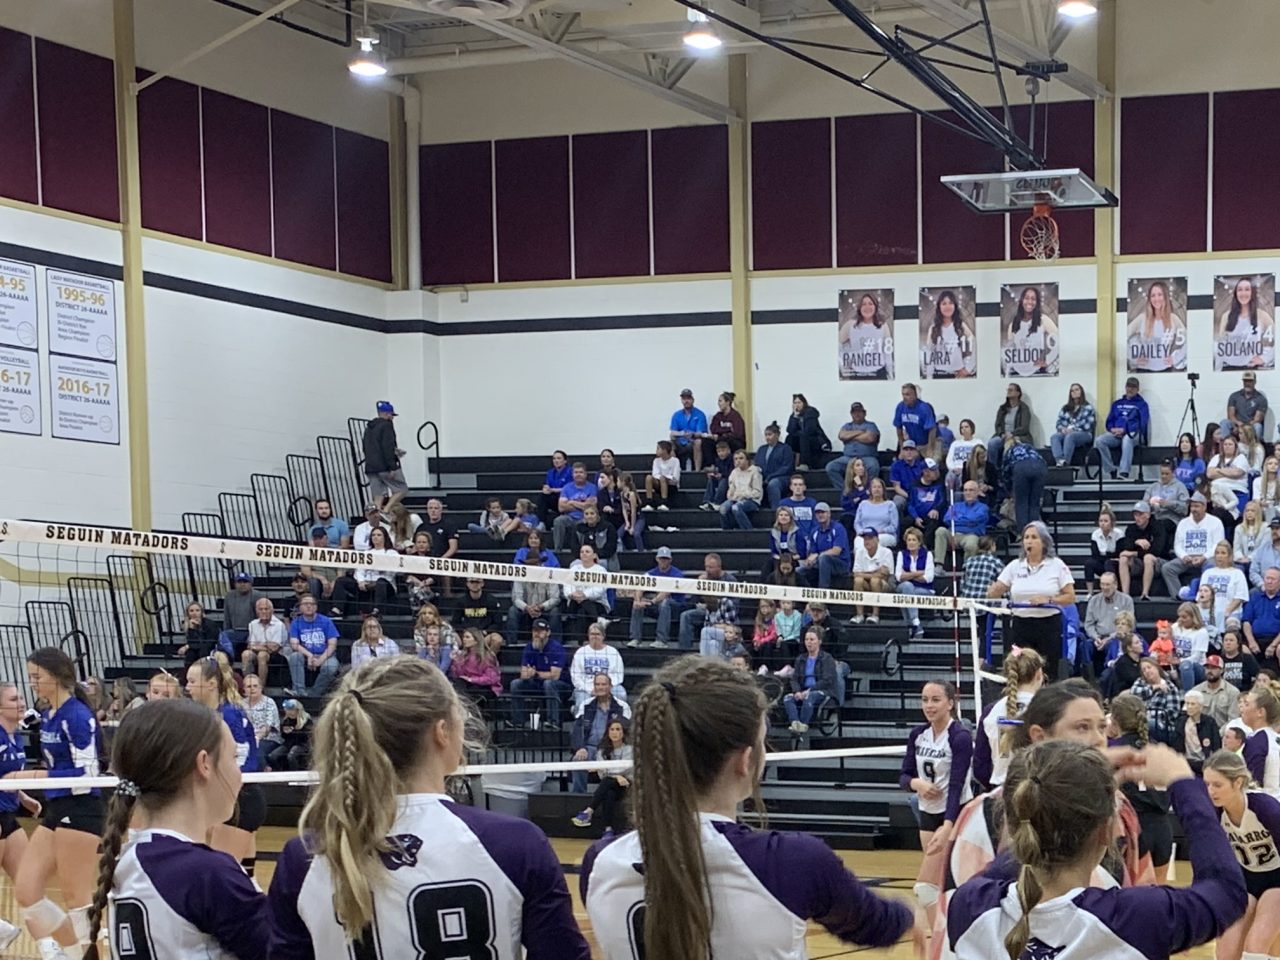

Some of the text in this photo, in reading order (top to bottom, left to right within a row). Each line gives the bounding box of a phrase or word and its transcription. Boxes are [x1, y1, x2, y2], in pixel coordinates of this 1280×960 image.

[0, 275, 26, 292] 4-95
[56, 286, 105, 306] 1995-96
[56, 301, 80, 311] DISTRICT
[863, 337, 893, 354] #18
[945, 335, 973, 353] #11
[1161, 328, 1186, 346] #5
[1005, 348, 1046, 364] SELDON
[1131, 344, 1169, 359] DAILEY
[1217, 340, 1264, 357] SOLANO
[843, 352, 883, 367] RANGEL
[923, 351, 951, 366] LARA
[0, 369, 31, 386] 6-17
[58, 377, 110, 397] 2016-17
[58, 393, 82, 402] DISTRICT
[46, 525, 189, 550] SEGUIN MATADORS
[256, 544, 374, 565] SEGUIN MATADORS
[429, 559, 527, 577] SEGUIN MATADORS
[574, 571, 657, 587] SEGUIN MATADORS
[697, 581, 768, 596] SEGUIN MATADORS
[801, 589, 864, 601] SEGUIN MATADORS
[923, 761, 936, 784] 9
[1233, 843, 1278, 866] 12
